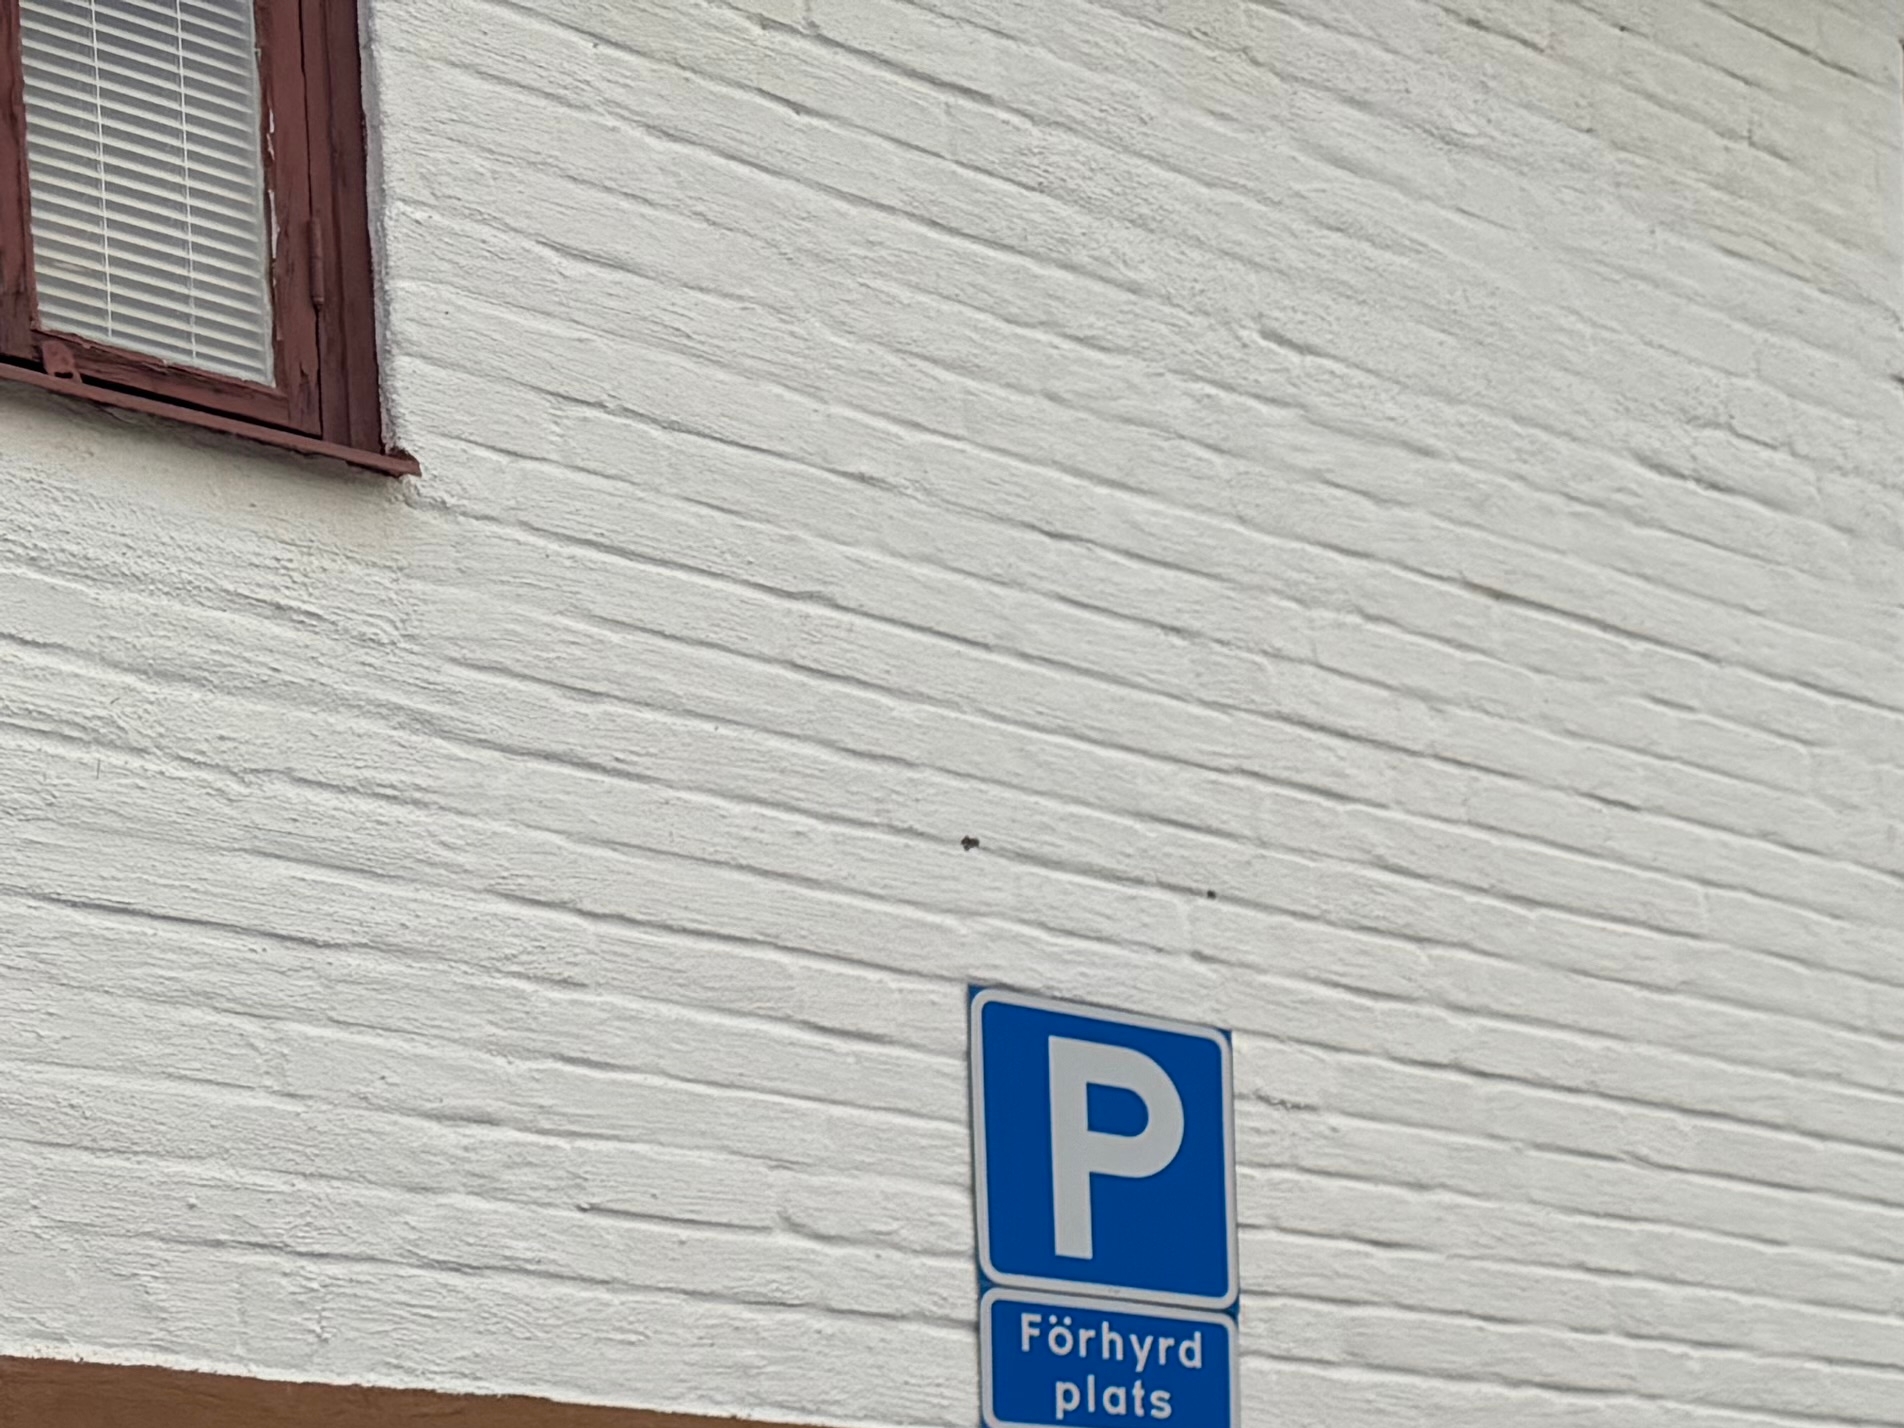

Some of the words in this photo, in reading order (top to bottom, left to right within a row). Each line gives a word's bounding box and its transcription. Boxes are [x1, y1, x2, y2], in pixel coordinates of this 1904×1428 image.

[1048, 1035, 1185, 1259] P
[1020, 1312, 1203, 1371] Förhyrd
[1055, 1374, 1173, 1420] plats
